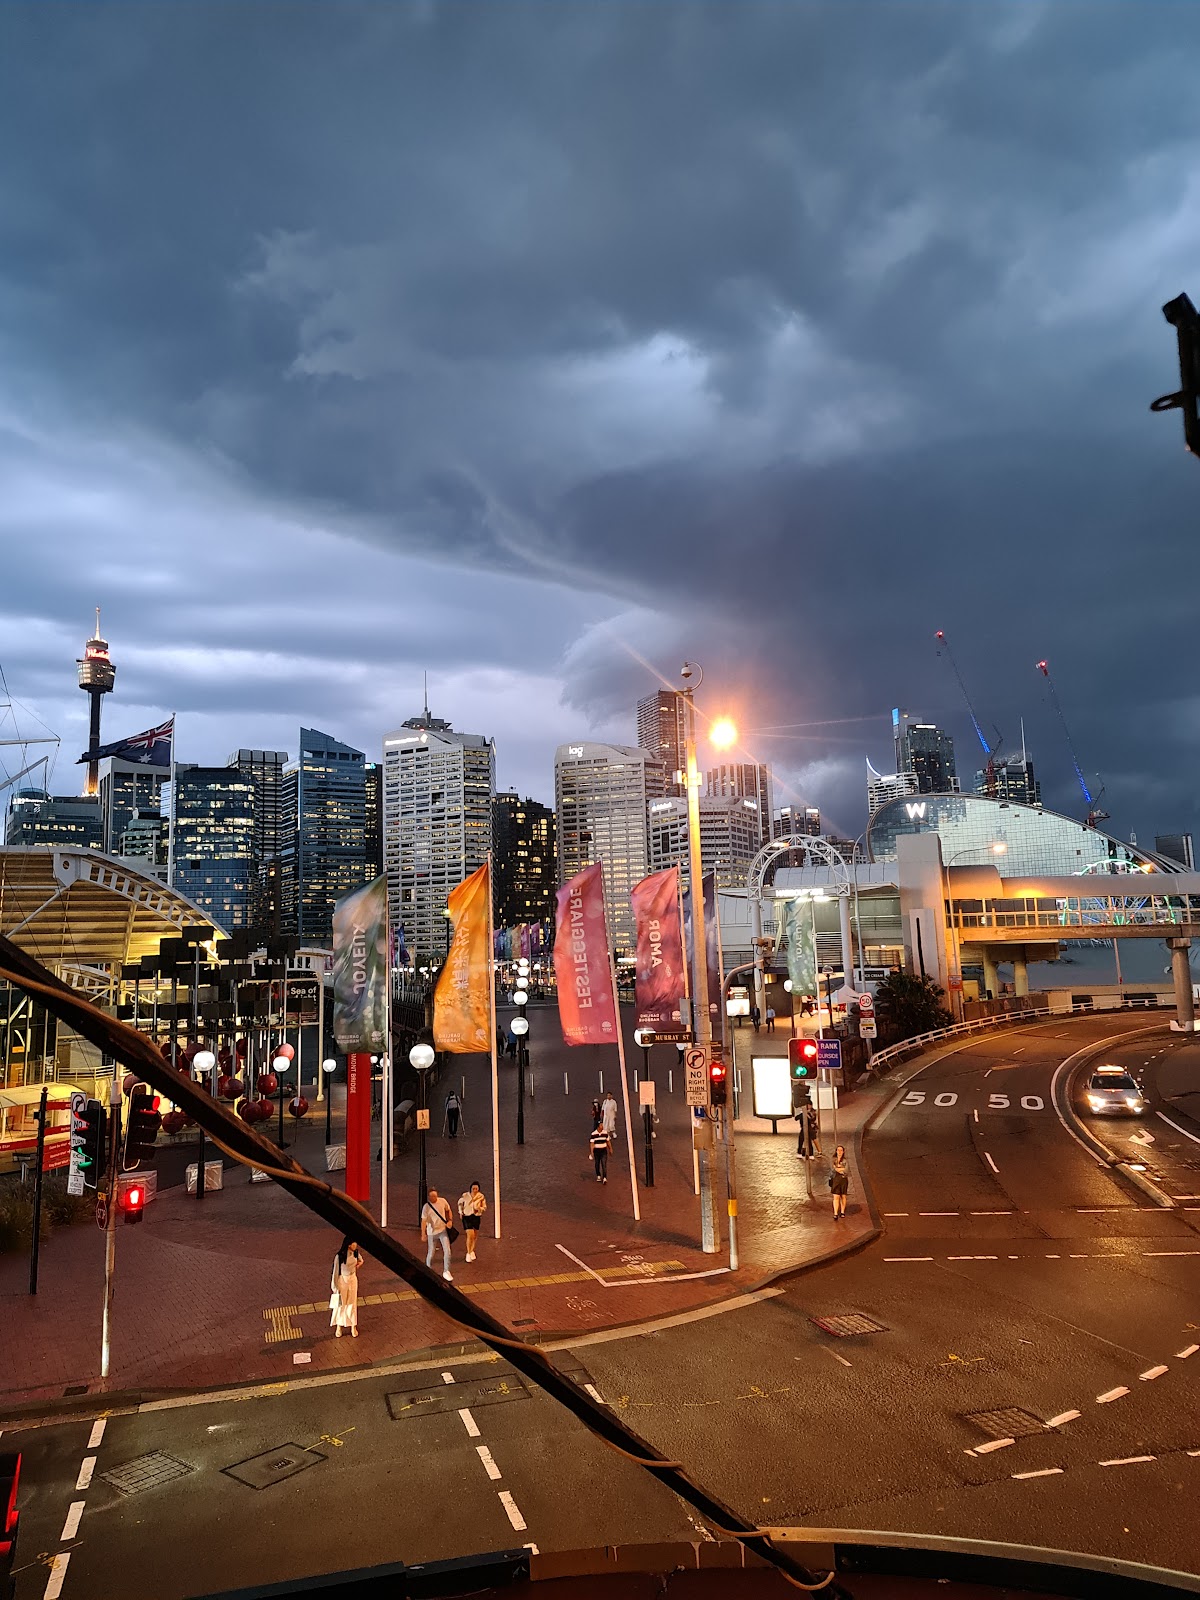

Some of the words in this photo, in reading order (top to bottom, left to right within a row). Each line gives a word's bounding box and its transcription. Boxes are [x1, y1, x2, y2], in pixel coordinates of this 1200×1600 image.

[905, 802, 926, 819] W
[290, 987, 306, 995] Sea
[307, 986, 317, 994] of
[901, 1091, 959, 1107] 50
[987, 1093, 1045, 1111] 50
[73, 1120, 83, 1129] NO
[97, 1208, 106, 1219] STOP
